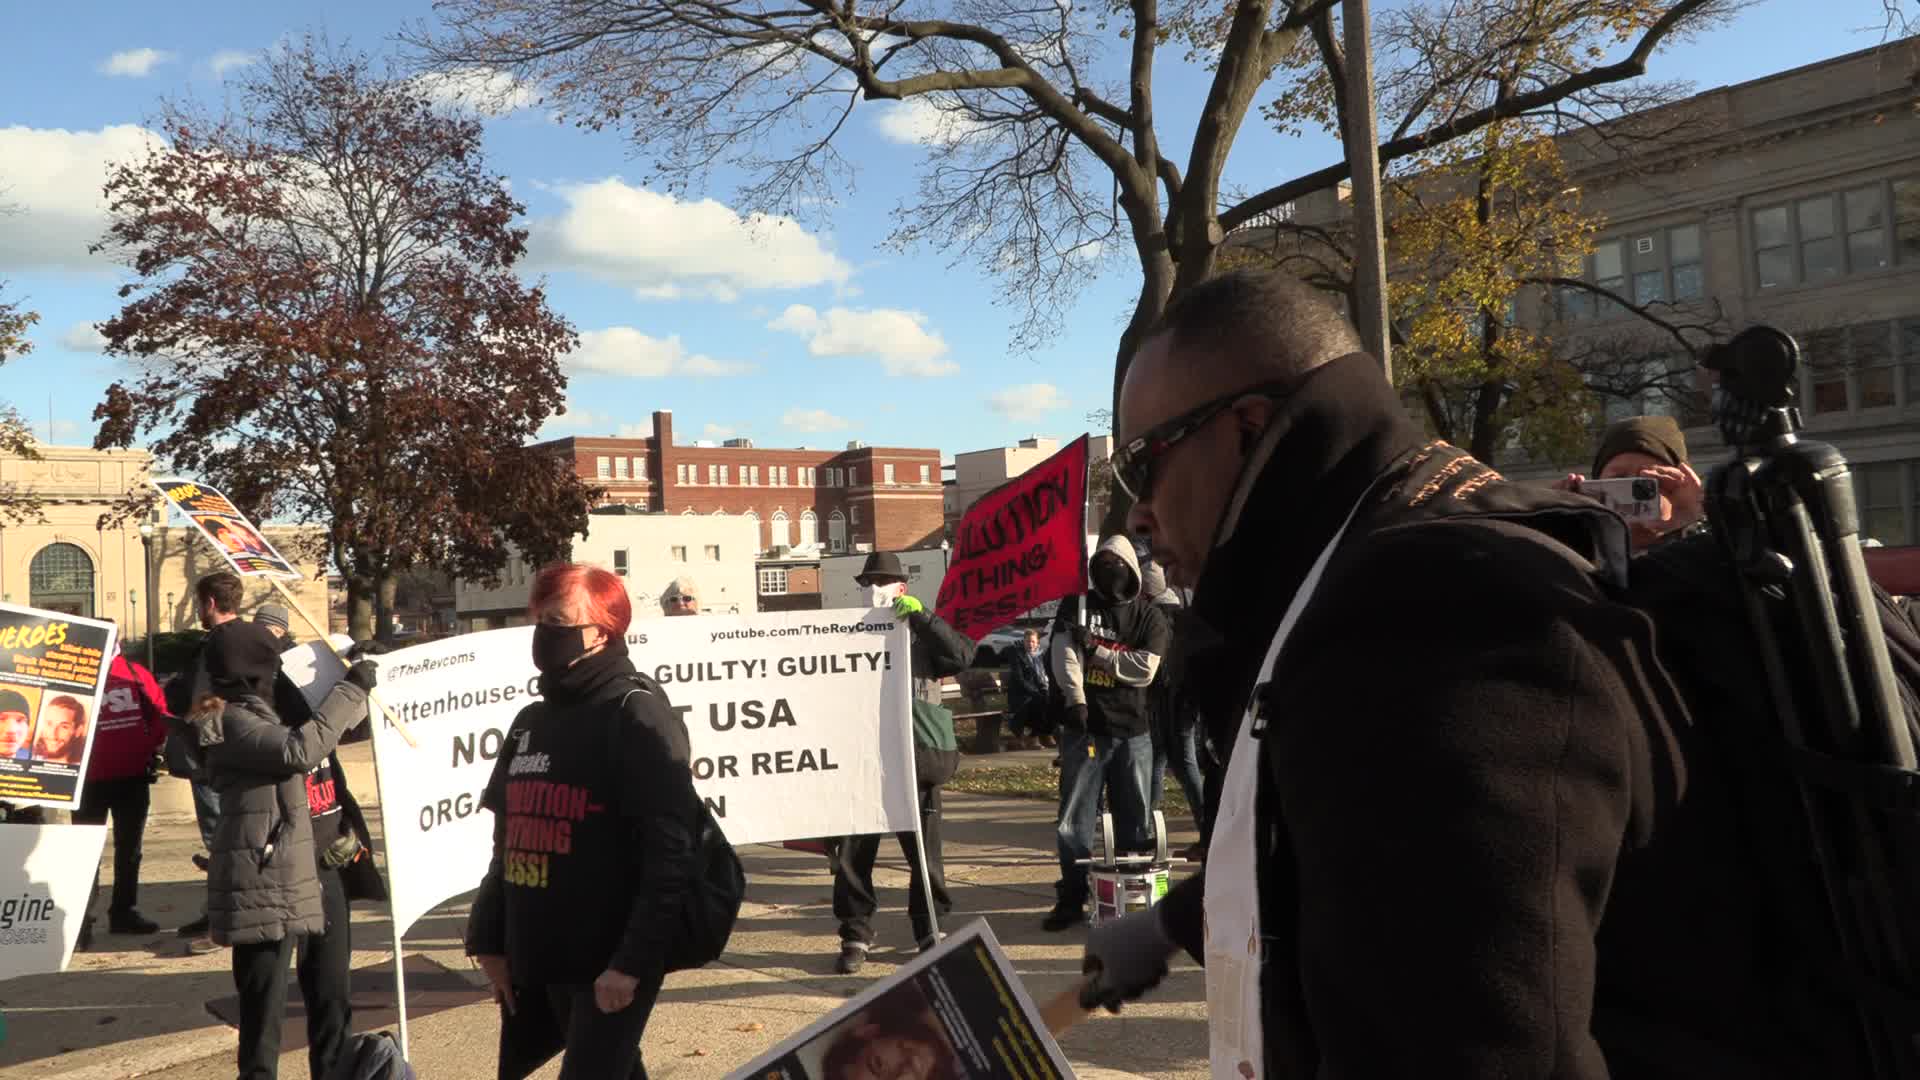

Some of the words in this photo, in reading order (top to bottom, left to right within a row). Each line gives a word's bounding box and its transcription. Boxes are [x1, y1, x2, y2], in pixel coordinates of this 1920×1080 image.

[710, 621, 895, 642] youtube.com/TheRevComs
[654, 658, 767, 685] GUILTY!
[776, 650, 892, 677] GUILTY!
[709, 698, 797, 732] USA
[751, 748, 839, 776] REAL
